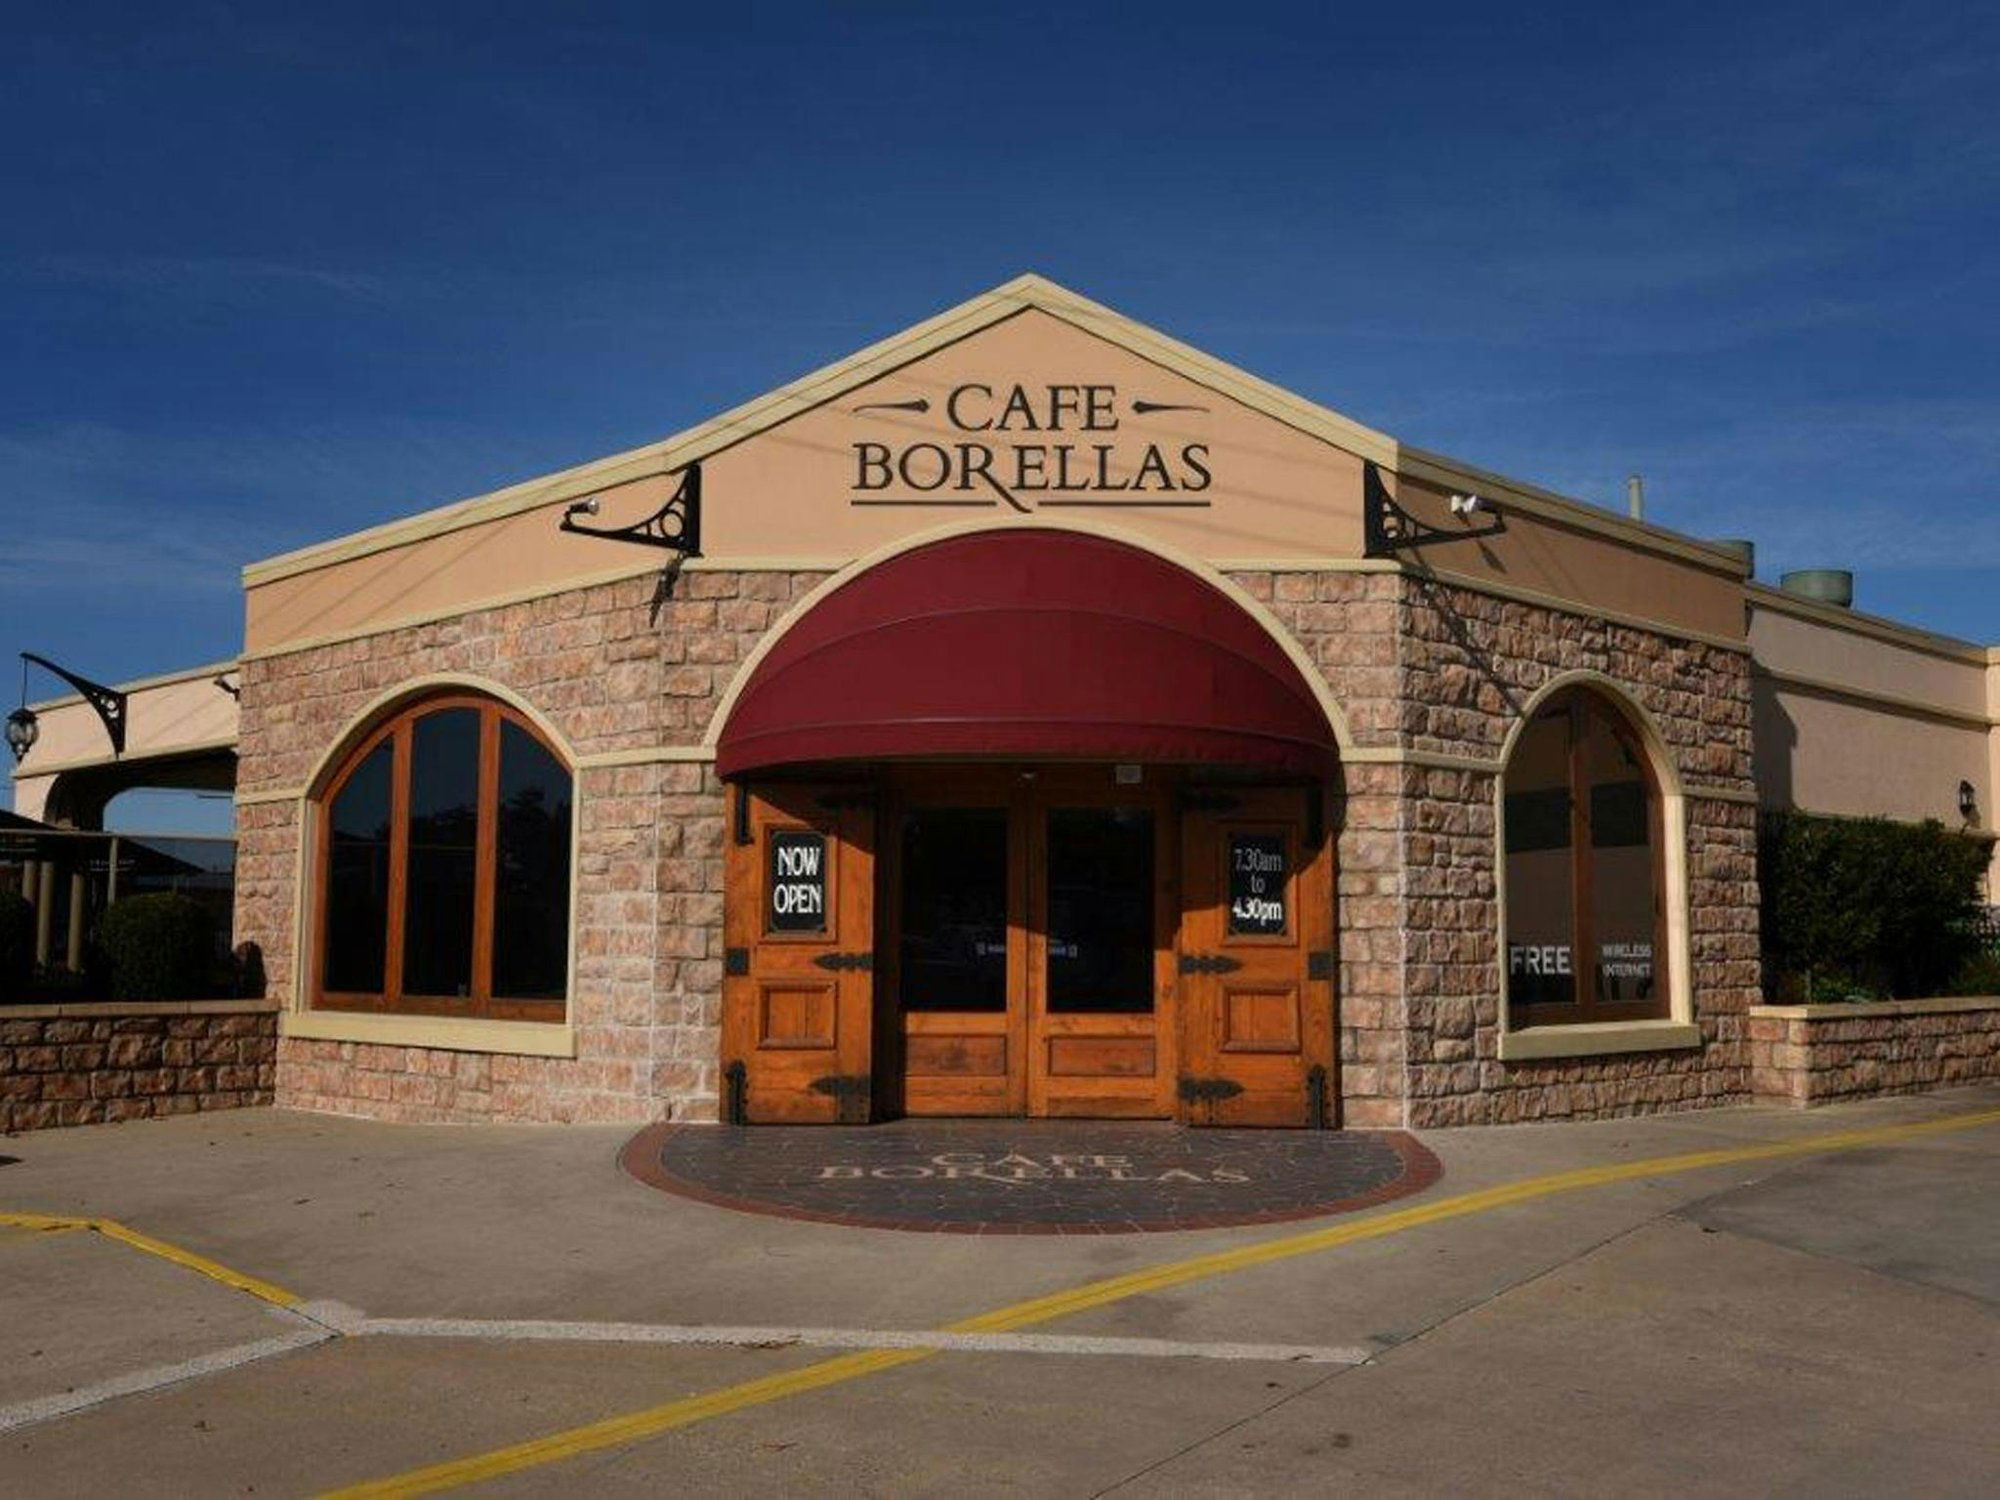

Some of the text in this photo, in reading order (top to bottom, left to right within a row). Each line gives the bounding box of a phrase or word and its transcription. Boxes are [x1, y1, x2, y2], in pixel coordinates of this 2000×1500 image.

[946, 383, 1120, 432] CAFE
[851, 442, 1212, 513] BORELLAS
[778, 847, 820, 876] NOW
[1251, 875, 1266, 893] to
[774, 884, 822, 914] OPEN
[1510, 946, 1571, 975] FREE
[931, 1153, 1133, 1168] CAFE
